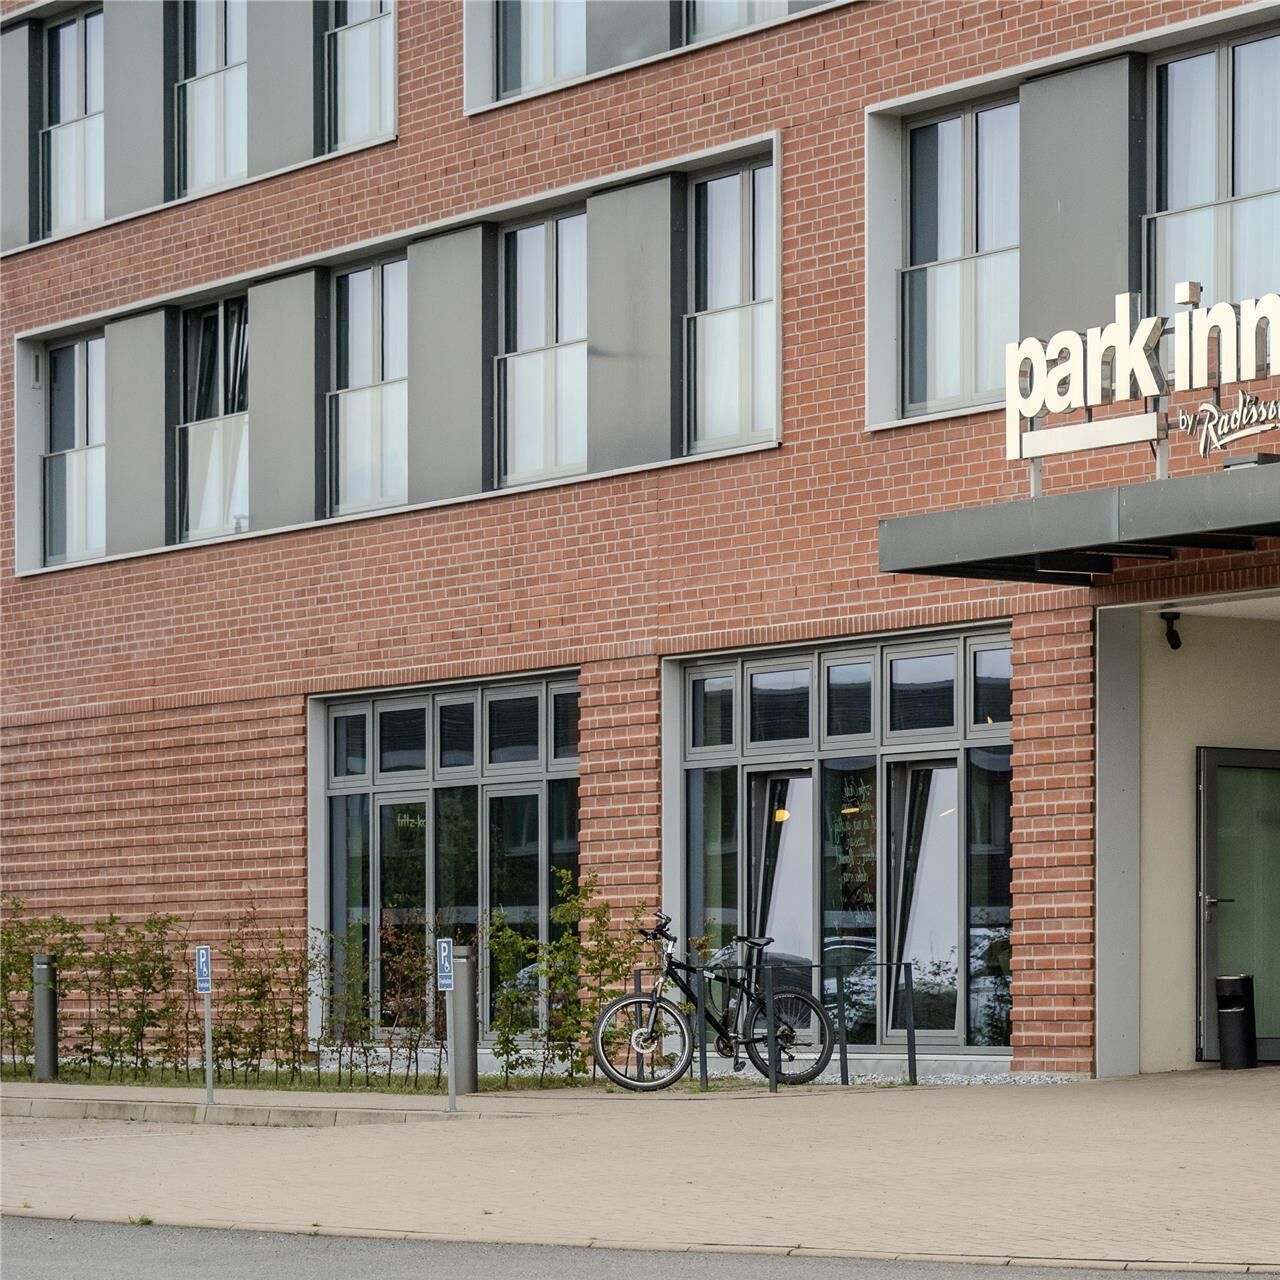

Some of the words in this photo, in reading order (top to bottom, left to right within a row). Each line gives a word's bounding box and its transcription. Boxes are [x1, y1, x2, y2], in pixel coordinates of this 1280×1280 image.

[1006, 292, 1164, 460] park
[1179, 409, 1197, 436] by
[199, 949, 206, 969] P
[441, 942, 449, 965] P
